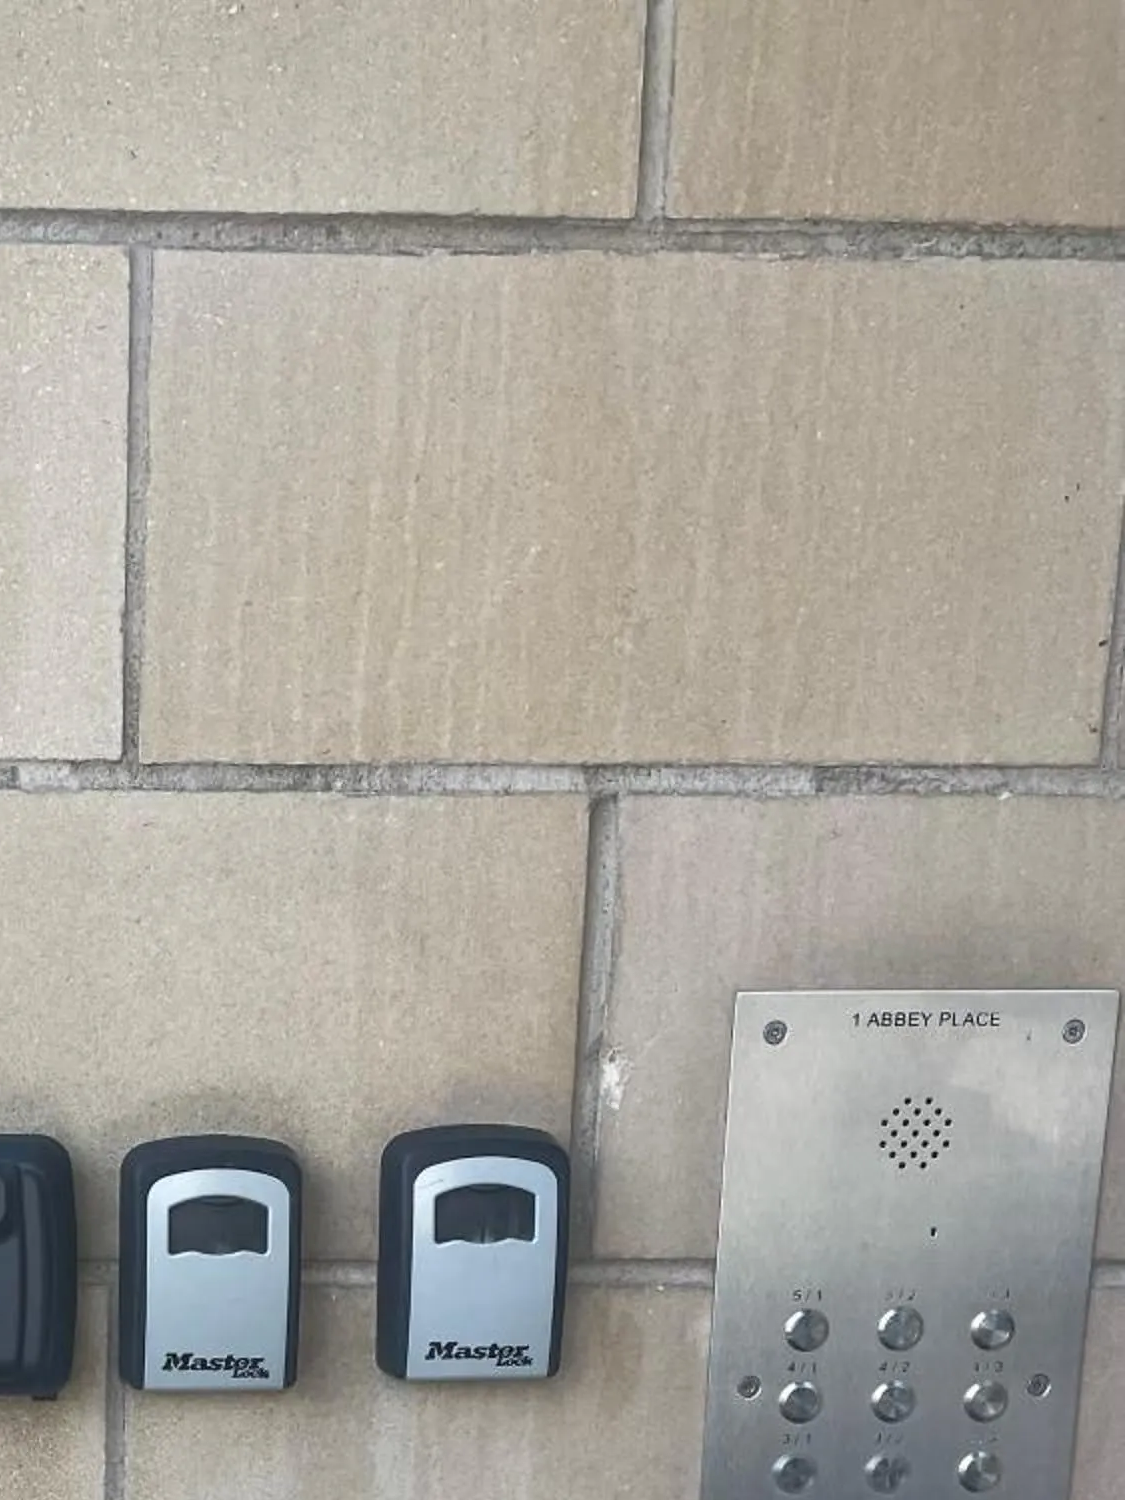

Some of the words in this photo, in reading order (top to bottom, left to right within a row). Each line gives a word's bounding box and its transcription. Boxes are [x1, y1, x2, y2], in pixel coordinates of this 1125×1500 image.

[852, 1012, 860, 1027] 1
[866, 1011, 933, 1027] ABBEY
[938, 1011, 1001, 1027] PLACE
[425, 1341, 529, 1360] Master
[162, 1352, 265, 1371] Master
[495, 1355, 533, 1367] Lock
[232, 1367, 269, 1379] Lock
